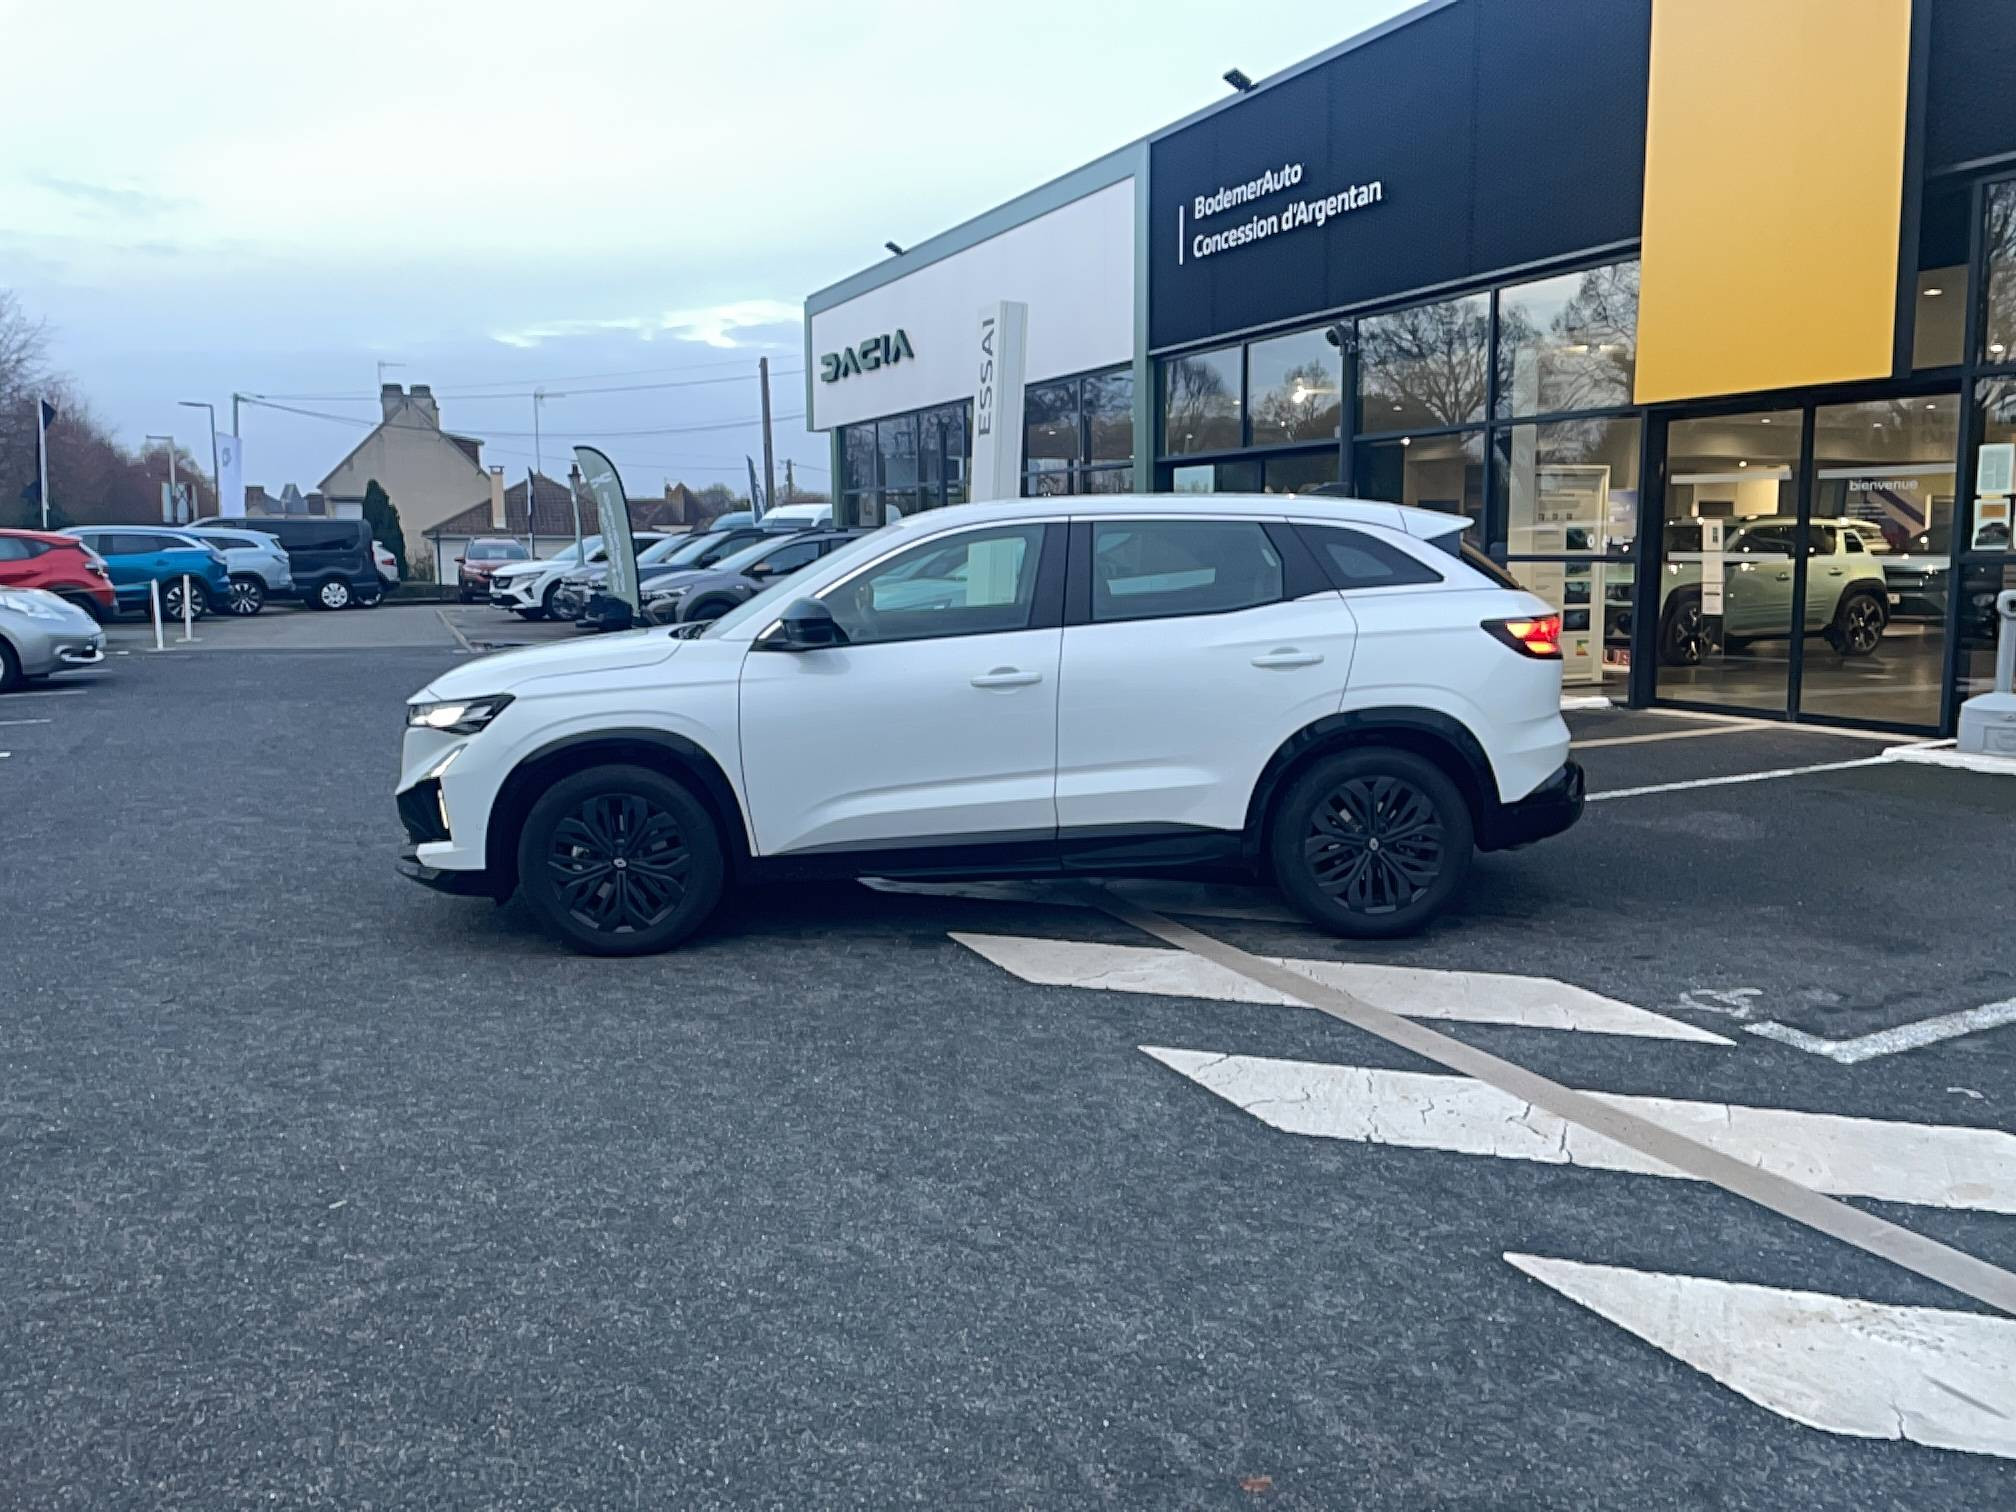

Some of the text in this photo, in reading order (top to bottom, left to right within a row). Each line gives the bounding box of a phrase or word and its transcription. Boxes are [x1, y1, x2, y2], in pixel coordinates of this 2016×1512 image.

[1193, 180, 1383, 258] Concession d'Argentan
[1194, 163, 1302, 219] BodemerAuto
[820, 329, 914, 382] DACIA
[978, 318, 995, 437] ESSAI
[1848, 479, 1919, 491] bienvenue
